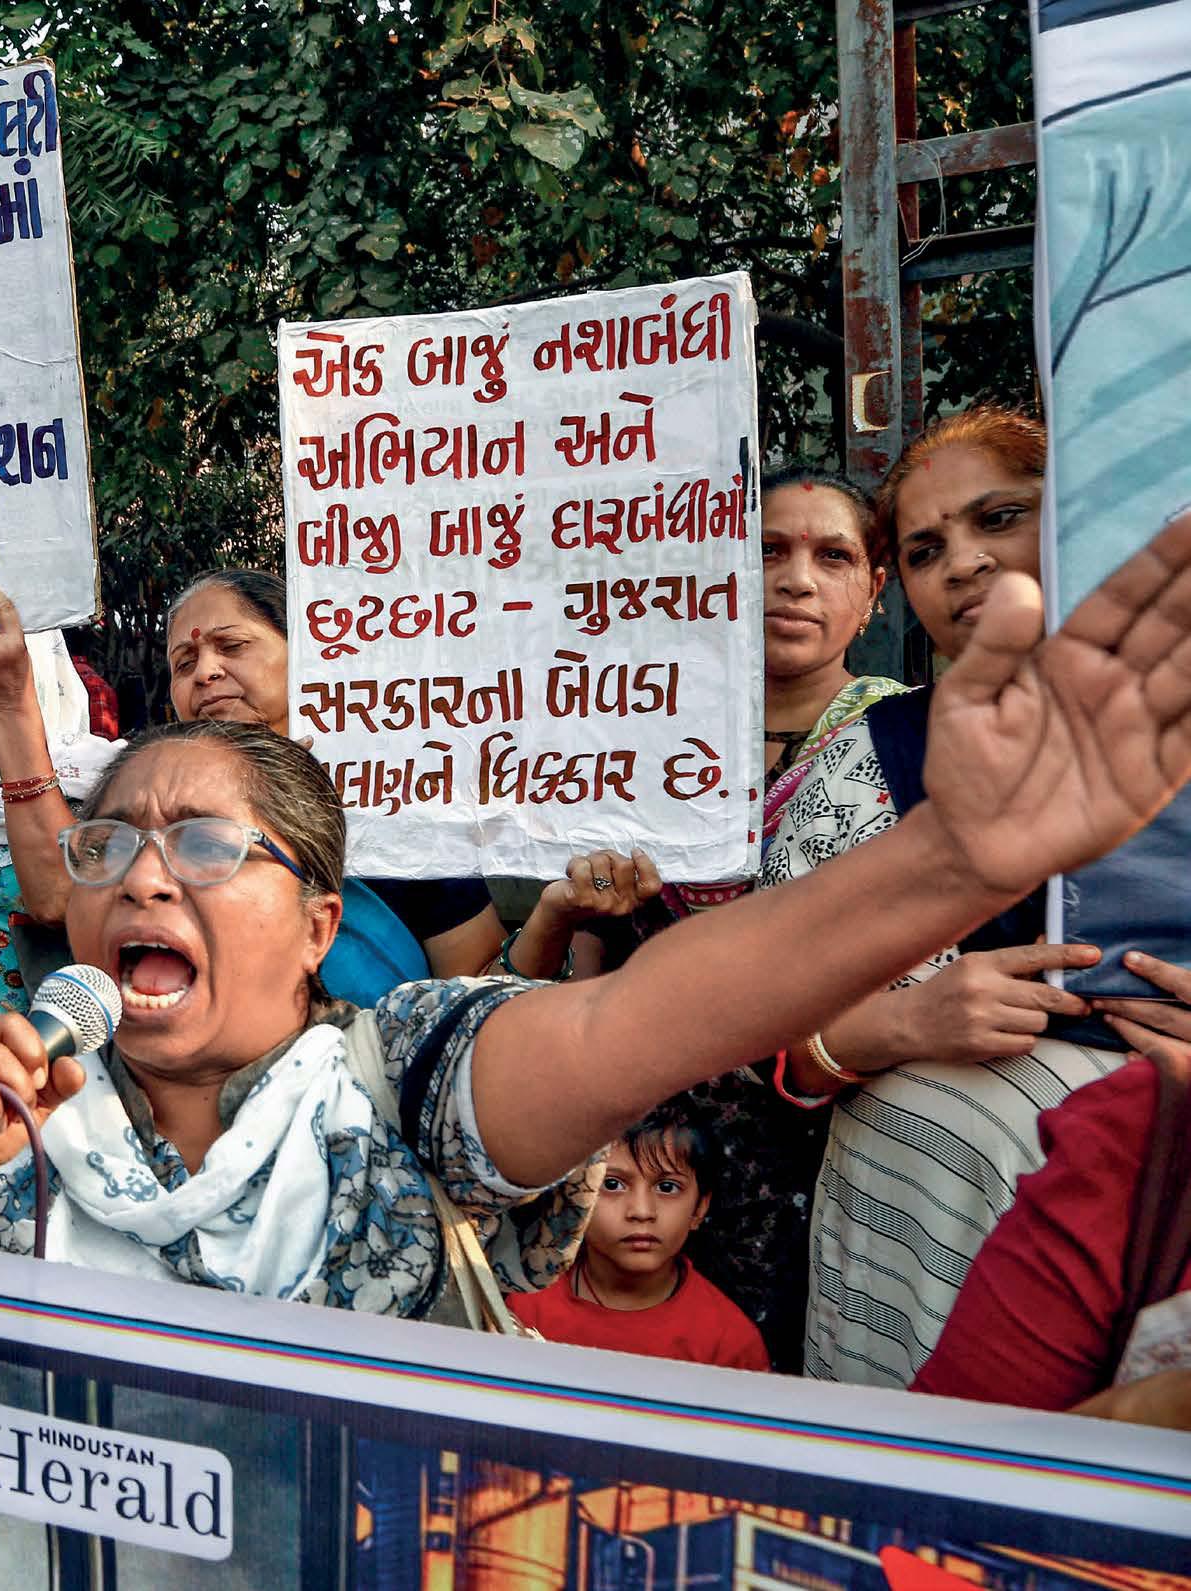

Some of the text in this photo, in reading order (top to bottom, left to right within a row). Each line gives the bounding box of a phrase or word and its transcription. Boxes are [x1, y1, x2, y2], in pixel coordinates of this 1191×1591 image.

[293, 331, 384, 397] એક
[534, 293, 731, 374] નશાબંધી
[297, 392, 657, 491] અભિયાન અને
[298, 503, 402, 574] બીજી
[307, 590, 479, 660] છૂટછાટ
[564, 571, 738, 635] ગુજરાત
[299, 649, 679, 733] સરકારના બેવડા
[322, 741, 453, 816] લણને
[479, 731, 637, 806] ધિક્કાર
[39, 1427, 154, 1466] HINDUSTAN
